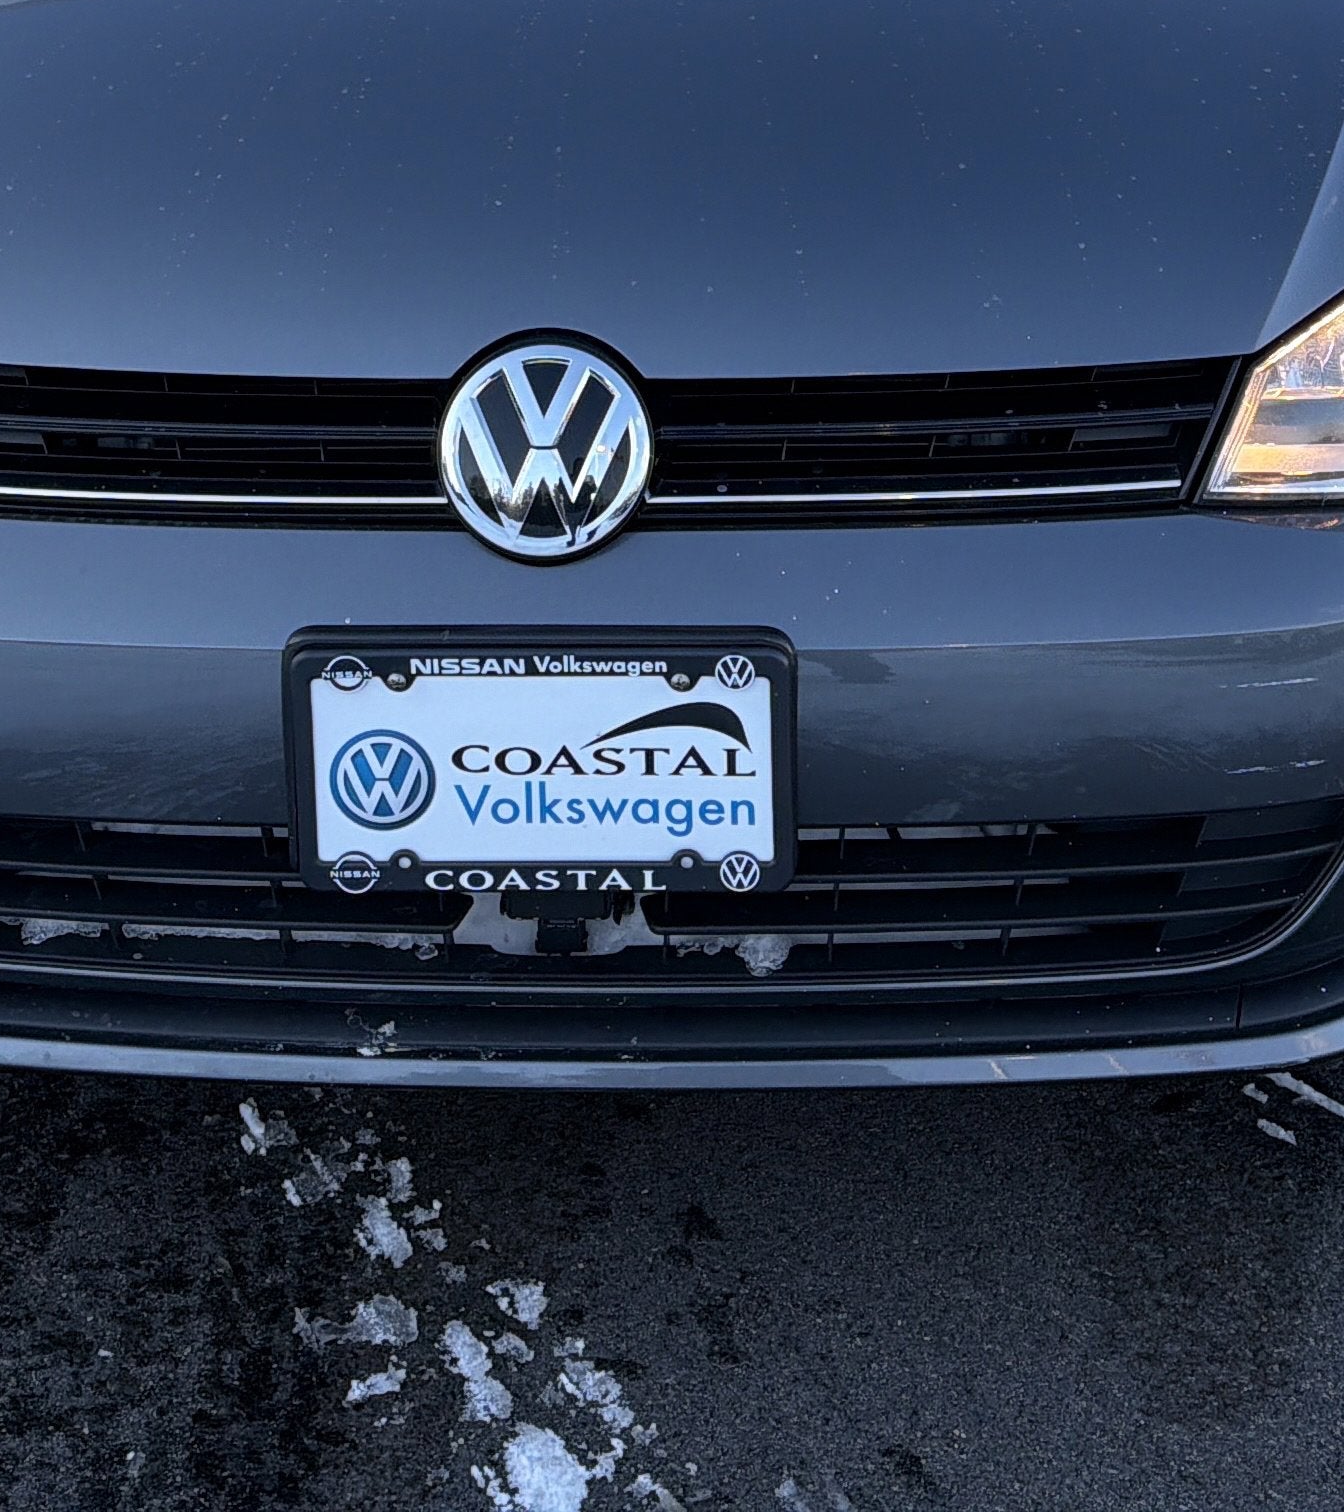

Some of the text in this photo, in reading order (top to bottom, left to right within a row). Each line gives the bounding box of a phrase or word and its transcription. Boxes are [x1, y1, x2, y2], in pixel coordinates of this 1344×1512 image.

[321, 670, 373, 679] NISSAN
[410, 655, 668, 677] NISSAN Volkswagen
[451, 744, 757, 777] COASTAL
[454, 781, 757, 837] Volkswagen
[330, 870, 381, 879] NISSAN
[425, 868, 667, 891] COASTAL
